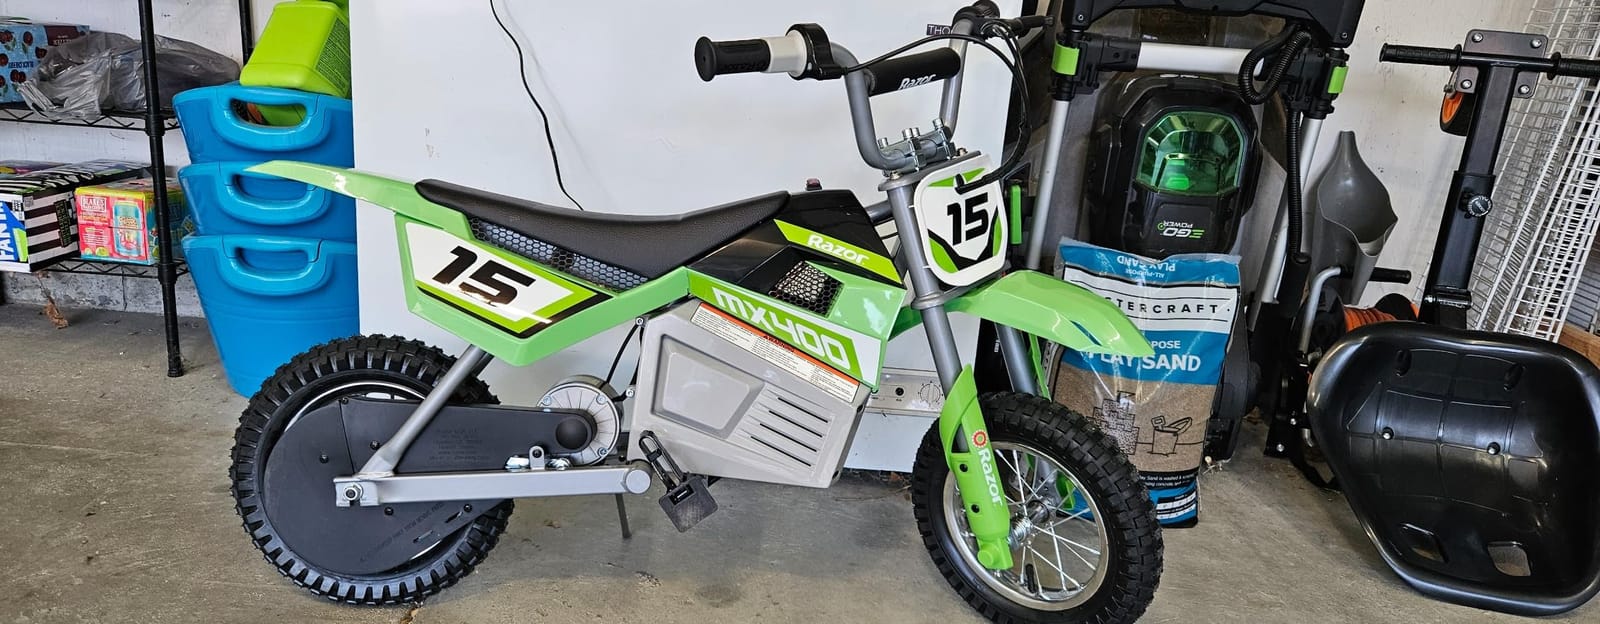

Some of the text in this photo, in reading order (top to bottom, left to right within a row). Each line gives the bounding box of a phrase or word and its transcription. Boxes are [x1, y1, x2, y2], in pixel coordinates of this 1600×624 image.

[928, 24, 951, 35] THO
[898, 74, 937, 90] Razor
[0, 201, 14, 260] FAN
[947, 192, 989, 246] 15
[1163, 220, 1193, 229] POWER
[1162, 227, 1205, 239] EGO
[807, 233, 869, 266] Razor
[432, 244, 536, 307] 15
[711, 286, 851, 371] MX400
[1152, 340, 1181, 349] POSE
[1143, 354, 1202, 372] SAND
[977, 447, 1003, 507] Razor
